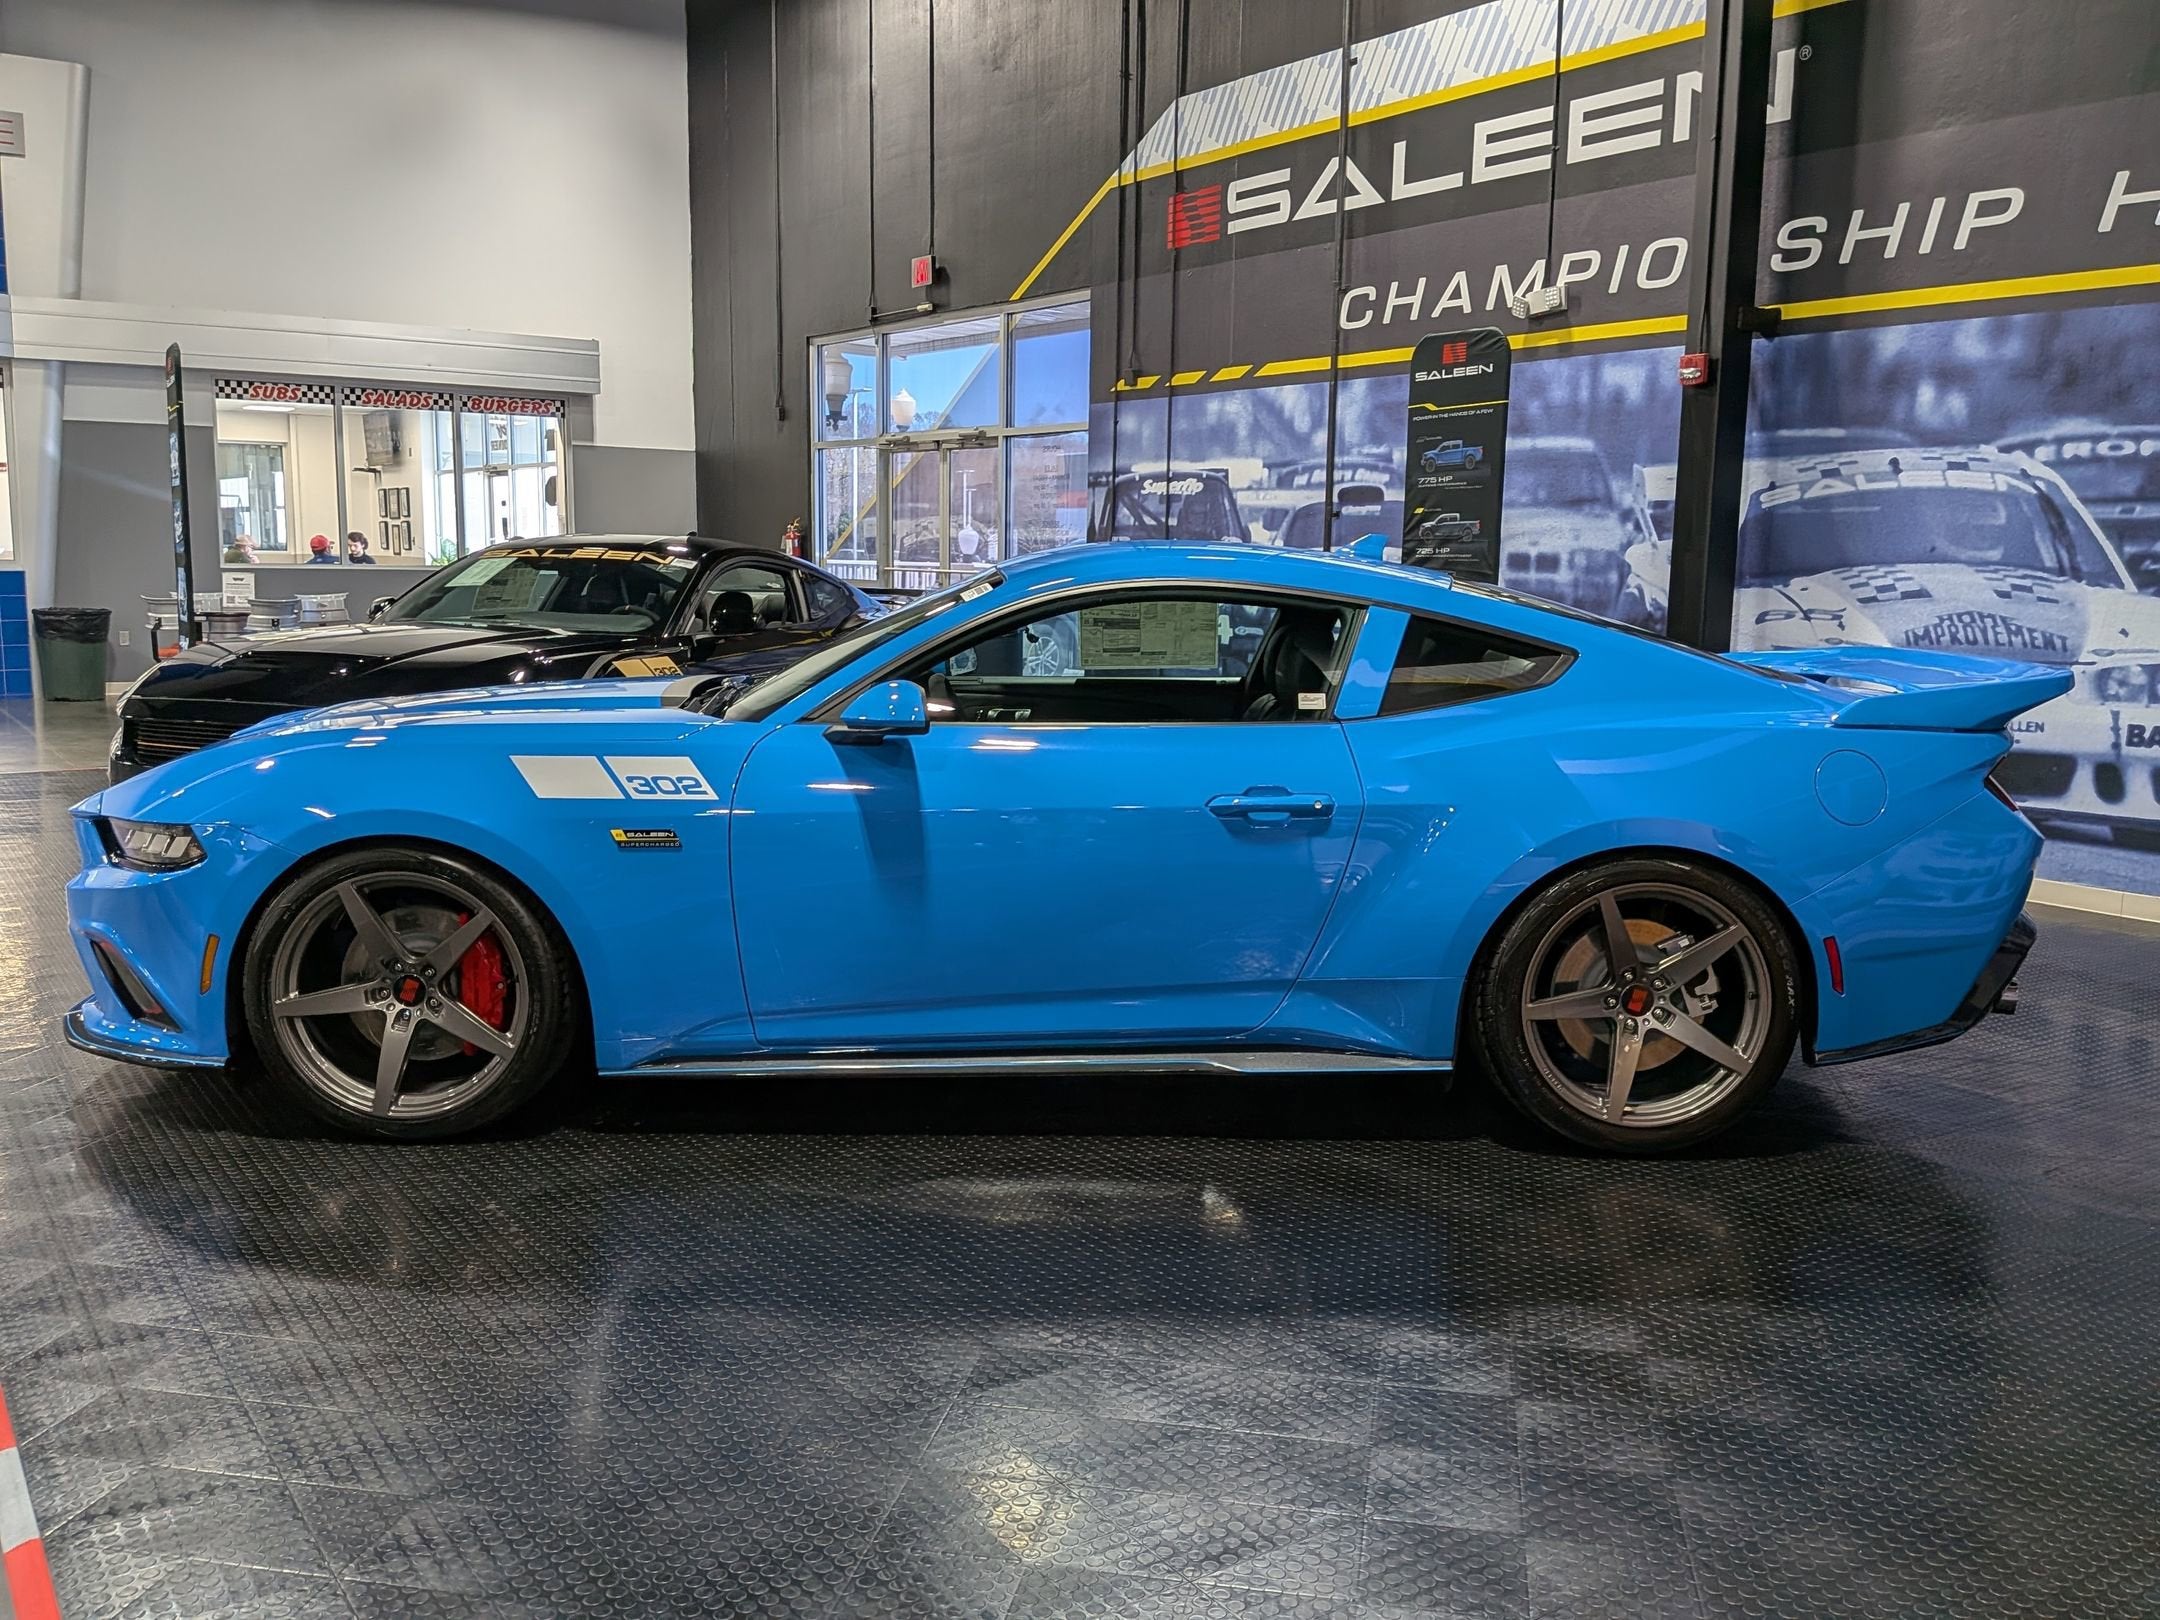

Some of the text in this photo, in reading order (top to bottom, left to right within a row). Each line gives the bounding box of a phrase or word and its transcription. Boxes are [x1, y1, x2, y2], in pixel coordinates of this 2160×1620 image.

[1415, 363, 1494, 382] SALEEN
[249, 384, 301, 401] SUBS
[361, 390, 433, 409] SALADS
[470, 397, 553, 415] BURGERS
[1417, 475, 1453, 484] 775 HP
[1760, 469, 2039, 509] SALEEN
[479, 548, 675, 565] SALEEN
[1933, 610, 2018, 627] HOME
[1904, 618, 2069, 653] IMPROVEMENT
[653, 666, 681, 676] 302
[625, 775, 709, 795] 302
